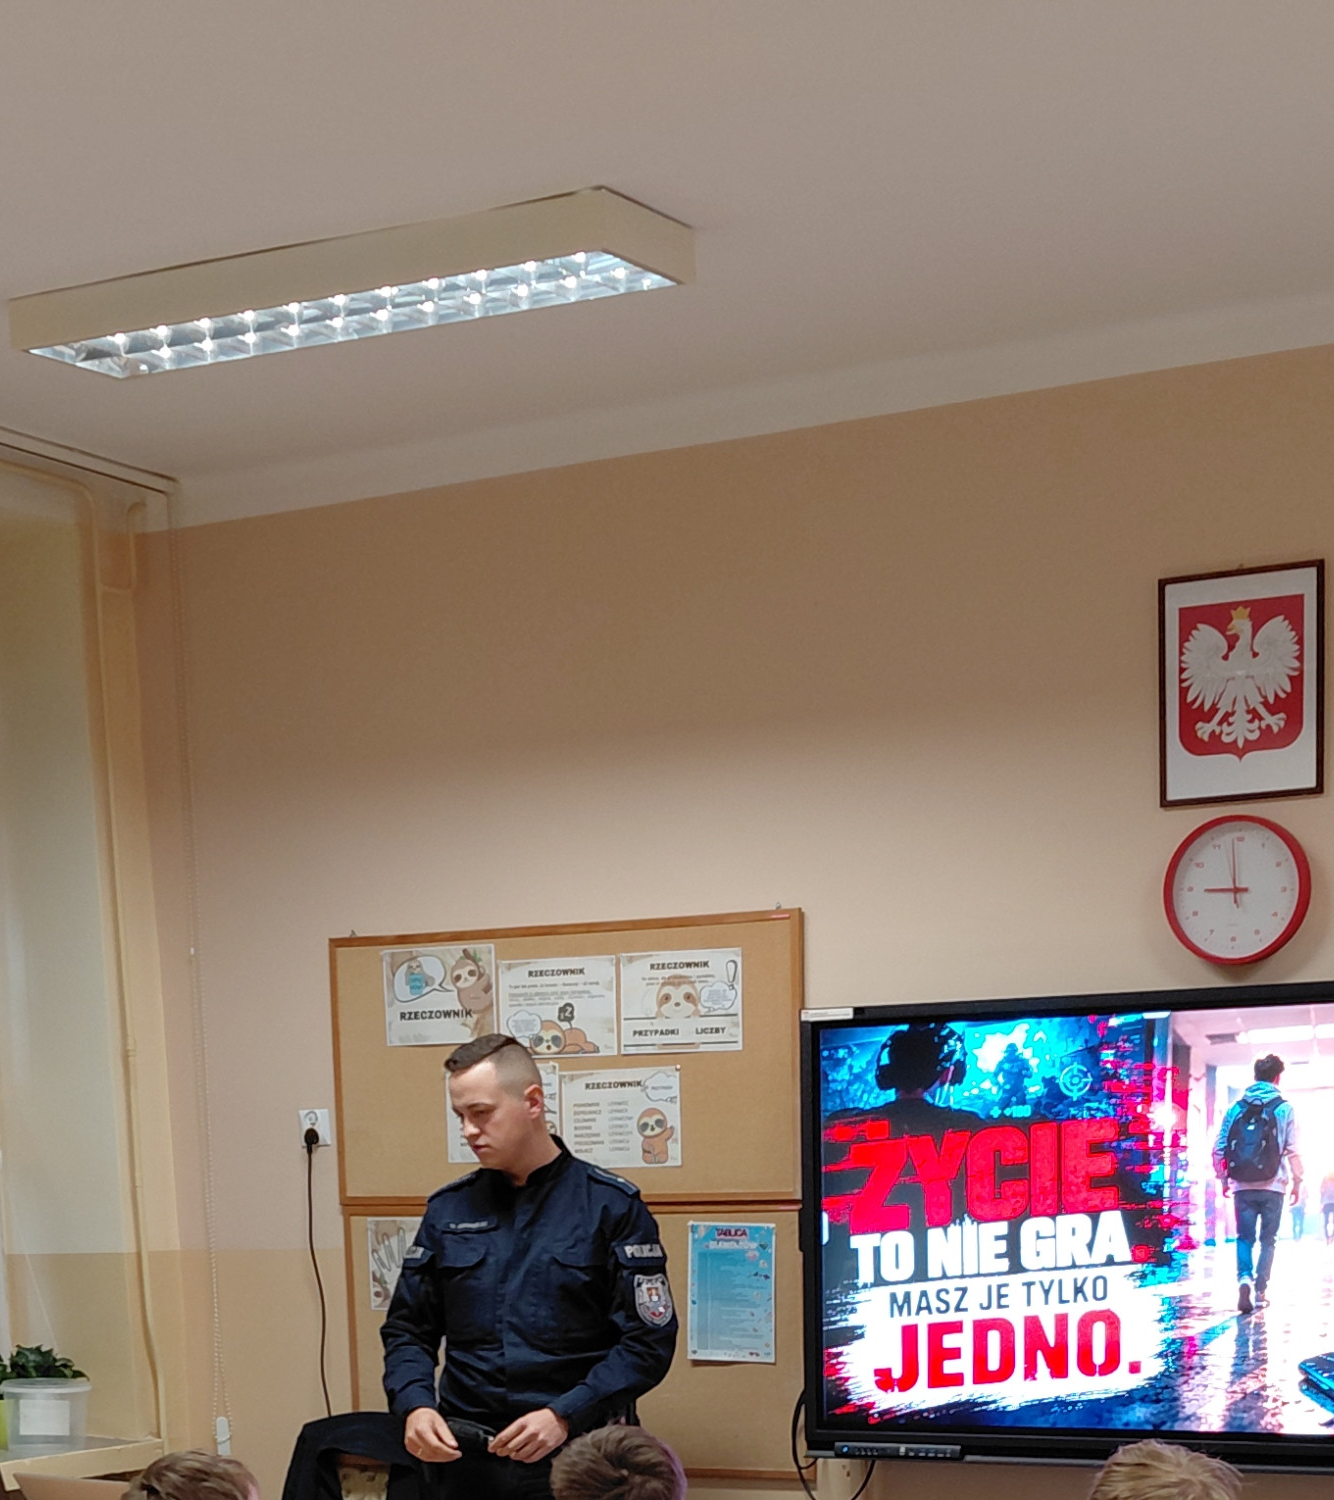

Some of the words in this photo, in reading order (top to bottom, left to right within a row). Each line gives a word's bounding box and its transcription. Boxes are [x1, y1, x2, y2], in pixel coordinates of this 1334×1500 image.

[650, 960, 710, 971] RZECZOWNIK
[528, 967, 585, 978] RZECZOWNIK
[400, 1009, 473, 1021] RZECZOWNIK
[632, 1028, 679, 1037] PRZYPADKI
[695, 1026, 726, 1035] LICZBY
[585, 1080, 643, 1090] RZECZOWNIK
[850, 1230, 915, 1287] TO
[927, 1220, 1009, 1279] NIE
[1020, 1210, 1132, 1270] GRA
[889, 1286, 969, 1318] MASZ
[978, 1283, 1010, 1311] JE
[1021, 1275, 1108, 1307] TYLKO
[874, 1308, 1142, 1393] JEDNO.
